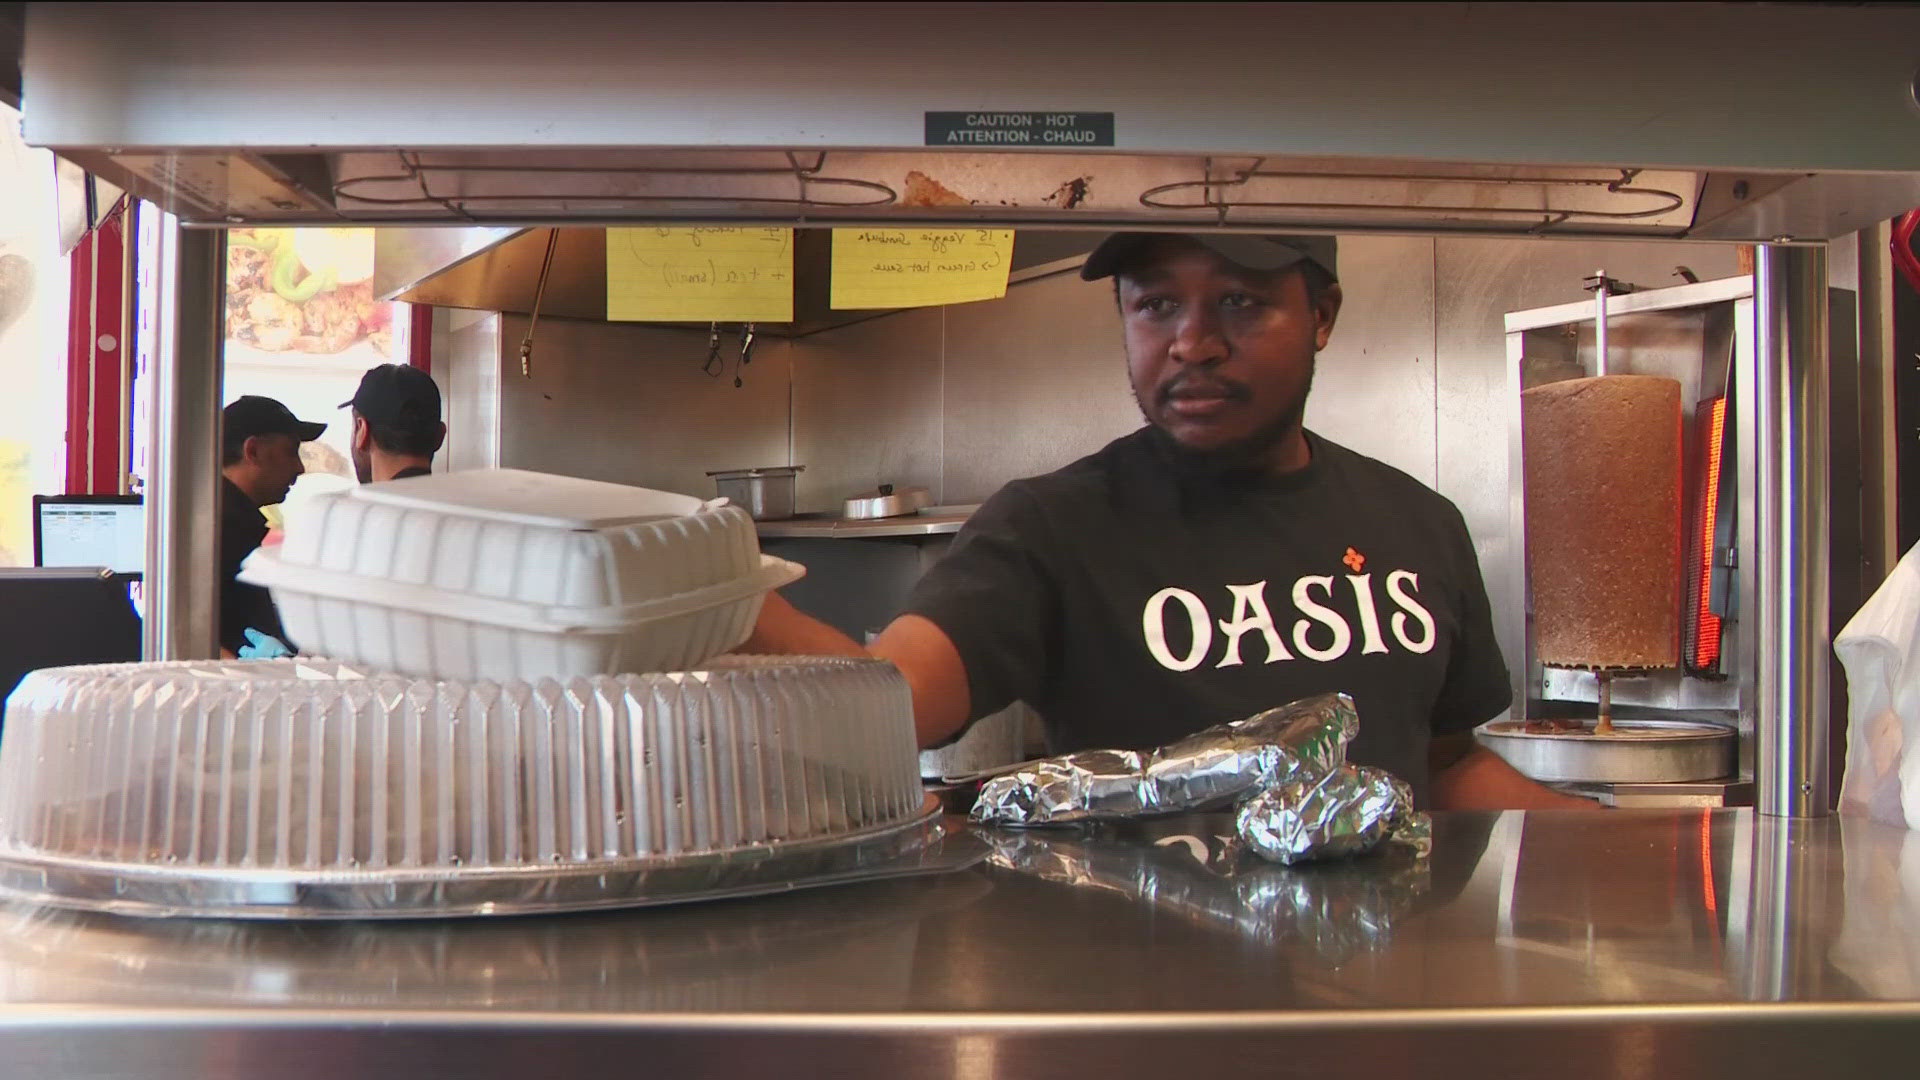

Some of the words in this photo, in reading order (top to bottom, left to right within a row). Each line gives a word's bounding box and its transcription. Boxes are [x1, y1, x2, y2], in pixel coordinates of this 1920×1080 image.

[966, 114, 1032, 127] CAUTION
[1046, 114, 1076, 127] HOT
[947, 130, 1030, 143] ATTENTION
[1043, 130, 1096, 143] CHAUD
[1142, 568, 1437, 672] OASIS
